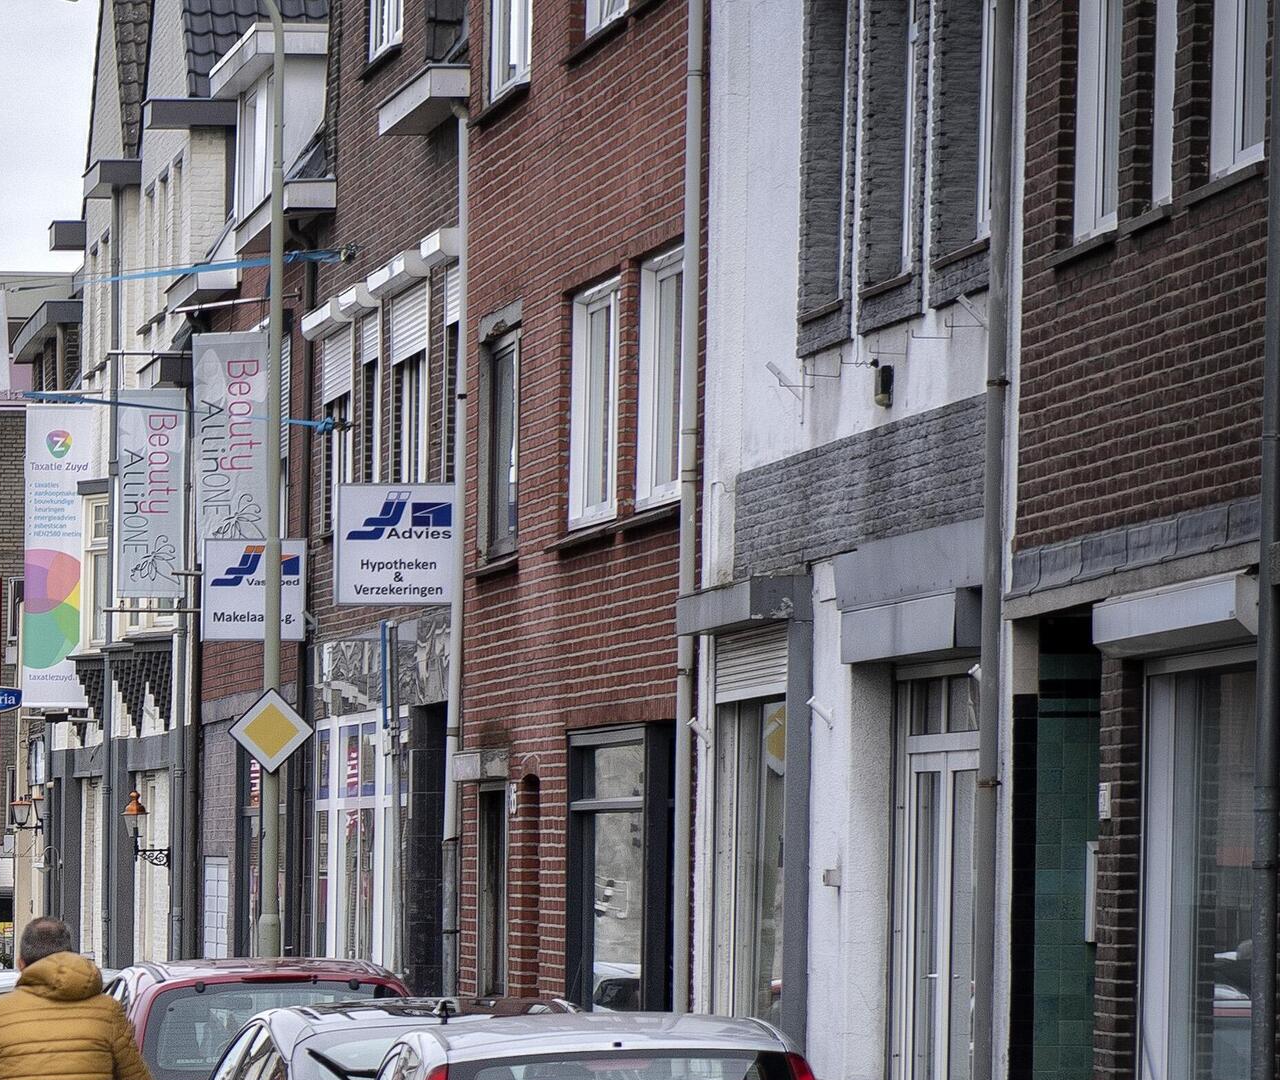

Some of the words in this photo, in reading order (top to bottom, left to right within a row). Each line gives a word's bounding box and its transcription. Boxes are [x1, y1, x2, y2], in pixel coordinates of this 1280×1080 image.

[219, 360, 262, 472] Beauty
[30, 462, 62, 471] Taxatie
[64, 462, 89, 473] Zuyd
[139, 414, 178, 516] Beauty
[386, 527, 453, 540] Advies
[360, 559, 437, 574] Hypotheken
[246, 577, 300, 587] Vasoed
[393, 572, 404, 582] &
[354, 583, 444, 598] Verzekeringen
